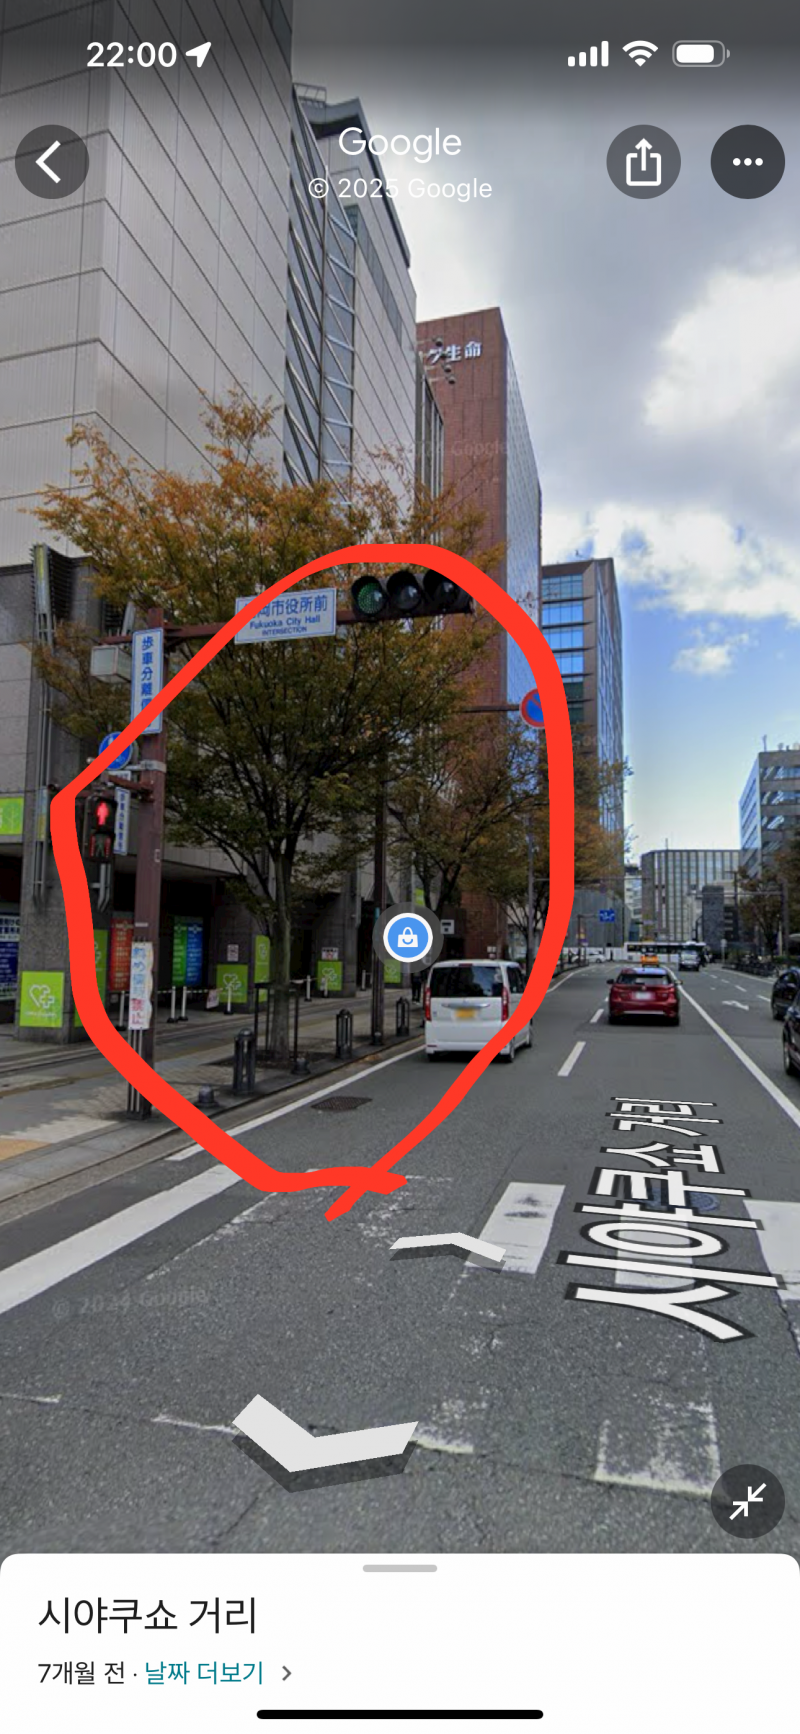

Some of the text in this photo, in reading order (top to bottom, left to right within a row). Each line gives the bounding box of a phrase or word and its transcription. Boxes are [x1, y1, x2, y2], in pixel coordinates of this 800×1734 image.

[245, 595, 328, 618] 岡市役所前
[250, 615, 321, 630] Fukuoka City Hall
[262, 625, 308, 637] INTERSECTION
